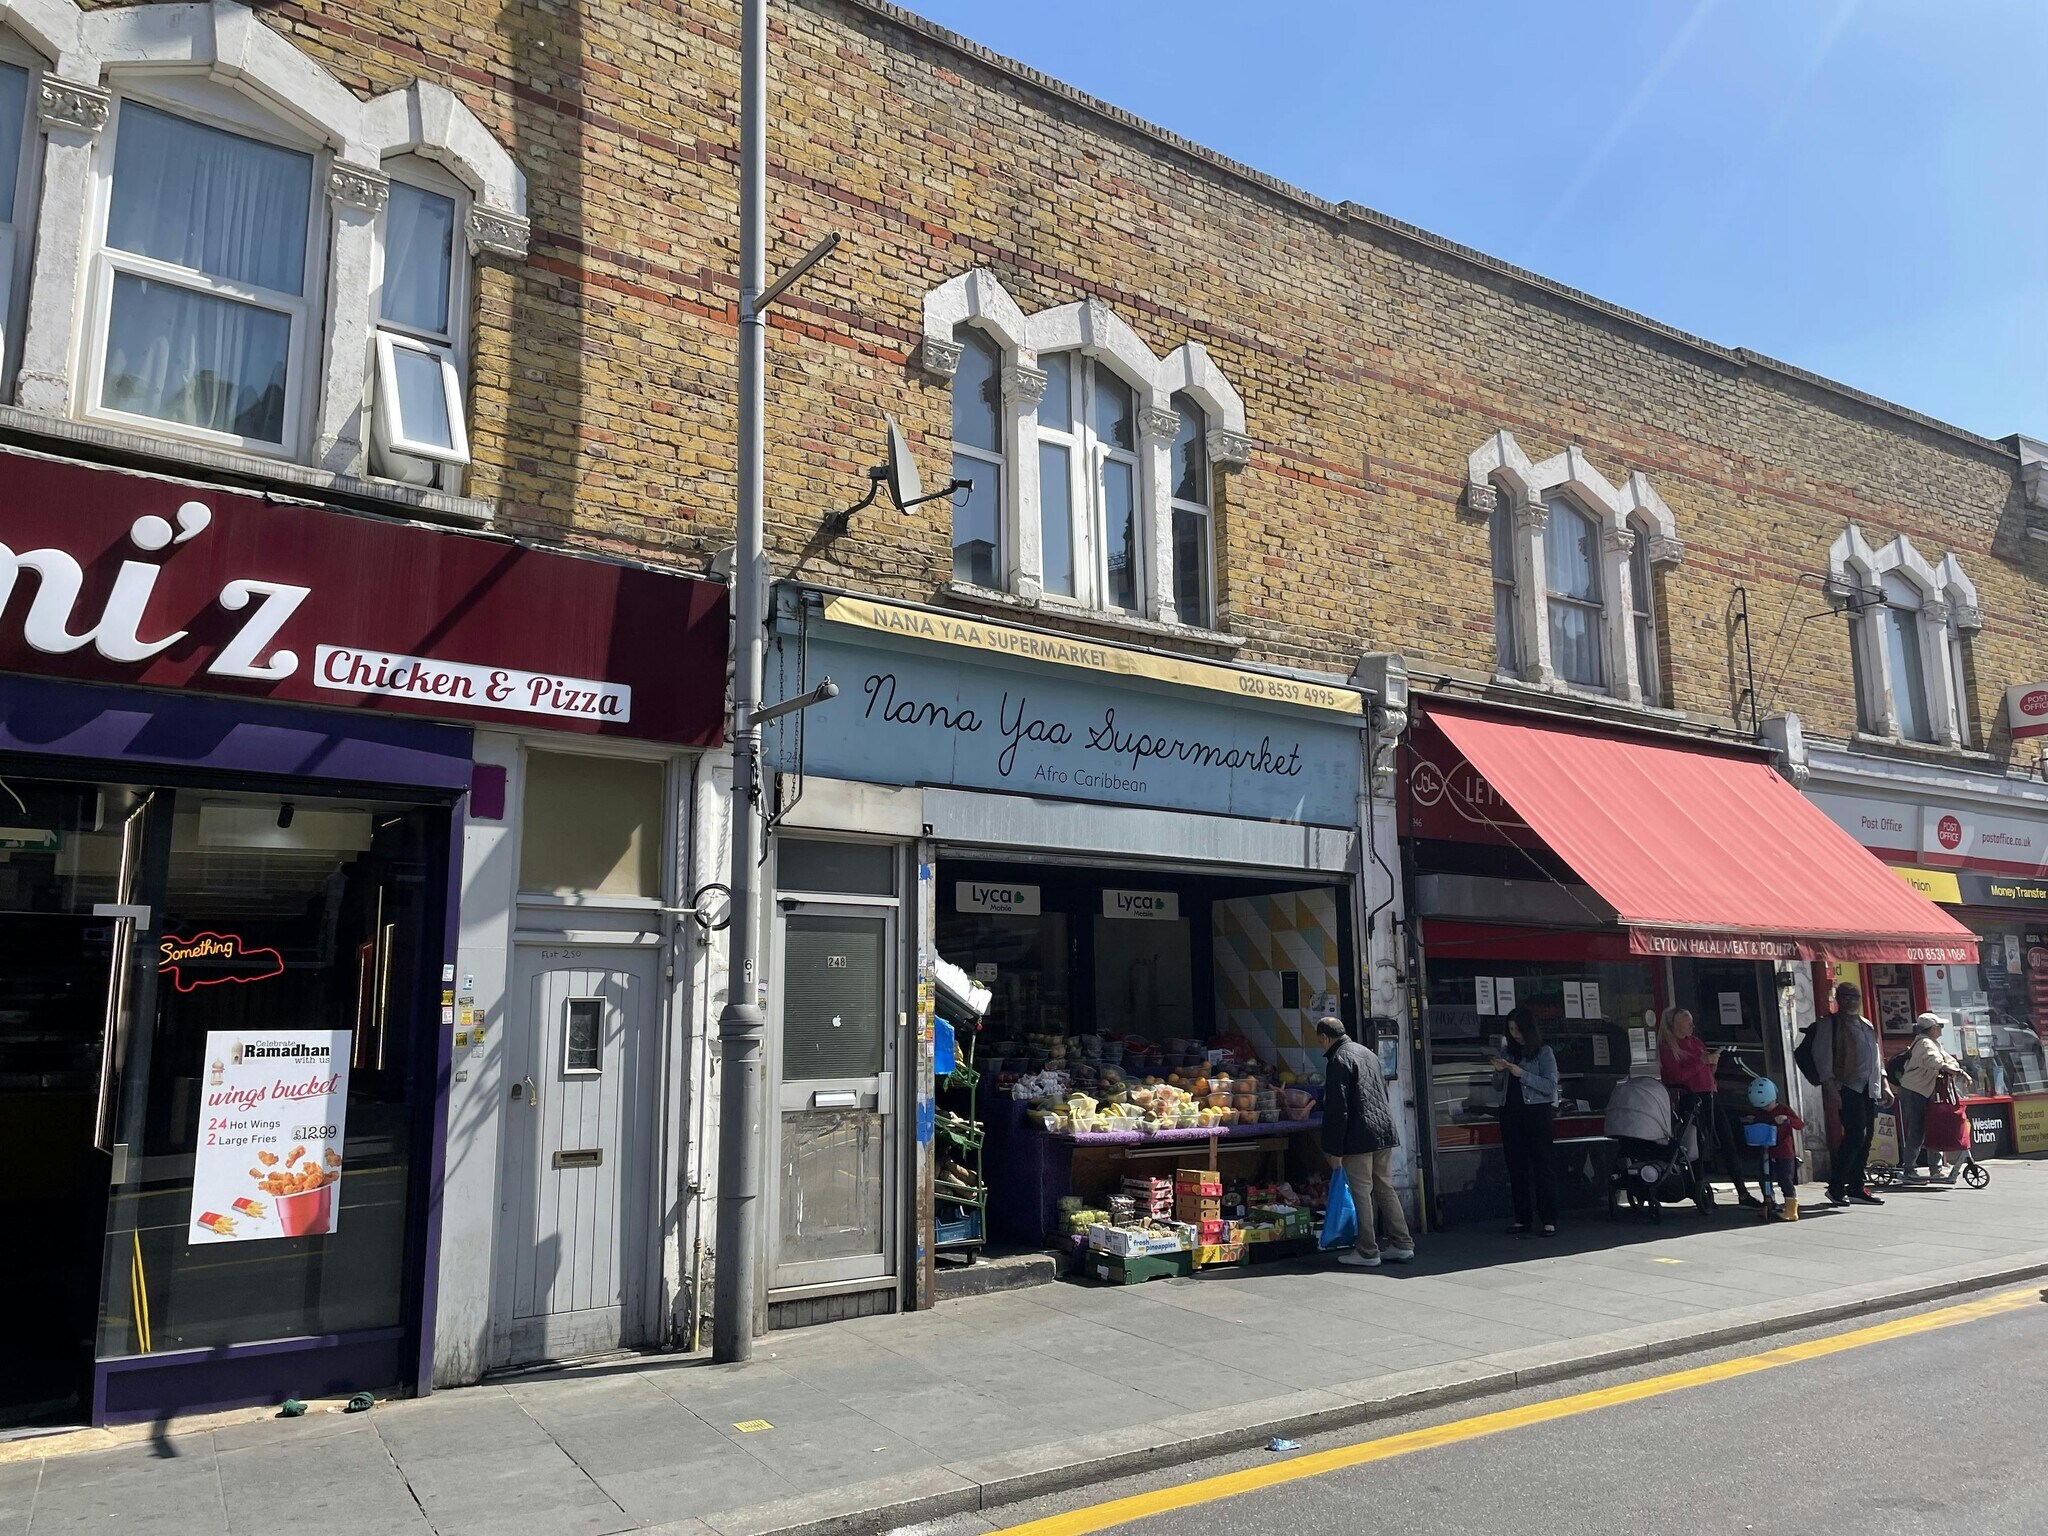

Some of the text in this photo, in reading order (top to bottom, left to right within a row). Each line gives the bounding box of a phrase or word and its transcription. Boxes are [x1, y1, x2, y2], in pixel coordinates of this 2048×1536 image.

[873, 607, 1107, 668] NANA YAA SUPERMARKET
[323, 649, 623, 716] Chicken & Pizza
[1239, 676, 1335, 706] 020 8539 4995
[2027, 694, 2048, 704] POST
[864, 674, 1302, 777] Nana Yaa Supermarket
[1034, 764, 1147, 793] Afro Caribbean
[1861, 815, 1903, 832] Post Office
[1943, 821, 1958, 832] POST
[1939, 830, 1959, 842] OFFICE
[1982, 832, 2031, 848] postoffice.co.uk
[972, 885, 1012, 905] Lyca
[1990, 885, 2047, 899] Money Transfer
[990, 904, 1012, 912] Mobile
[1117, 892, 1153, 912] Lyca
[1134, 909, 1153, 917] Mobile
[159, 939, 233, 966] Something
[1650, 934, 1798, 957] LEYTON HALAL MEAT & POULTRY
[562, 950, 582, 959] 250
[1907, 948, 1966, 961] 020 8539 1068
[2031, 953, 2040, 967] 30
[828, 957, 846, 967] 248
[244, 1044, 330, 1058] Ramadhan
[208, 1073, 342, 1112] wings bucket
[2018, 1110, 2045, 1120] Send and
[208, 1117, 281, 1131] 24 Hot Wings
[1972, 1117, 2002, 1131] Western
[2019, 1123, 2040, 1131] receive
[206, 1133, 277, 1146] 2 Large Fries
[293, 1125, 337, 1141] £12.99
[1973, 1130, 1996, 1143] Union
[2020, 1133, 2039, 1142] money
[1133, 1238, 1150, 1246] fresh
[1145, 1242, 1176, 1253] pineapples
